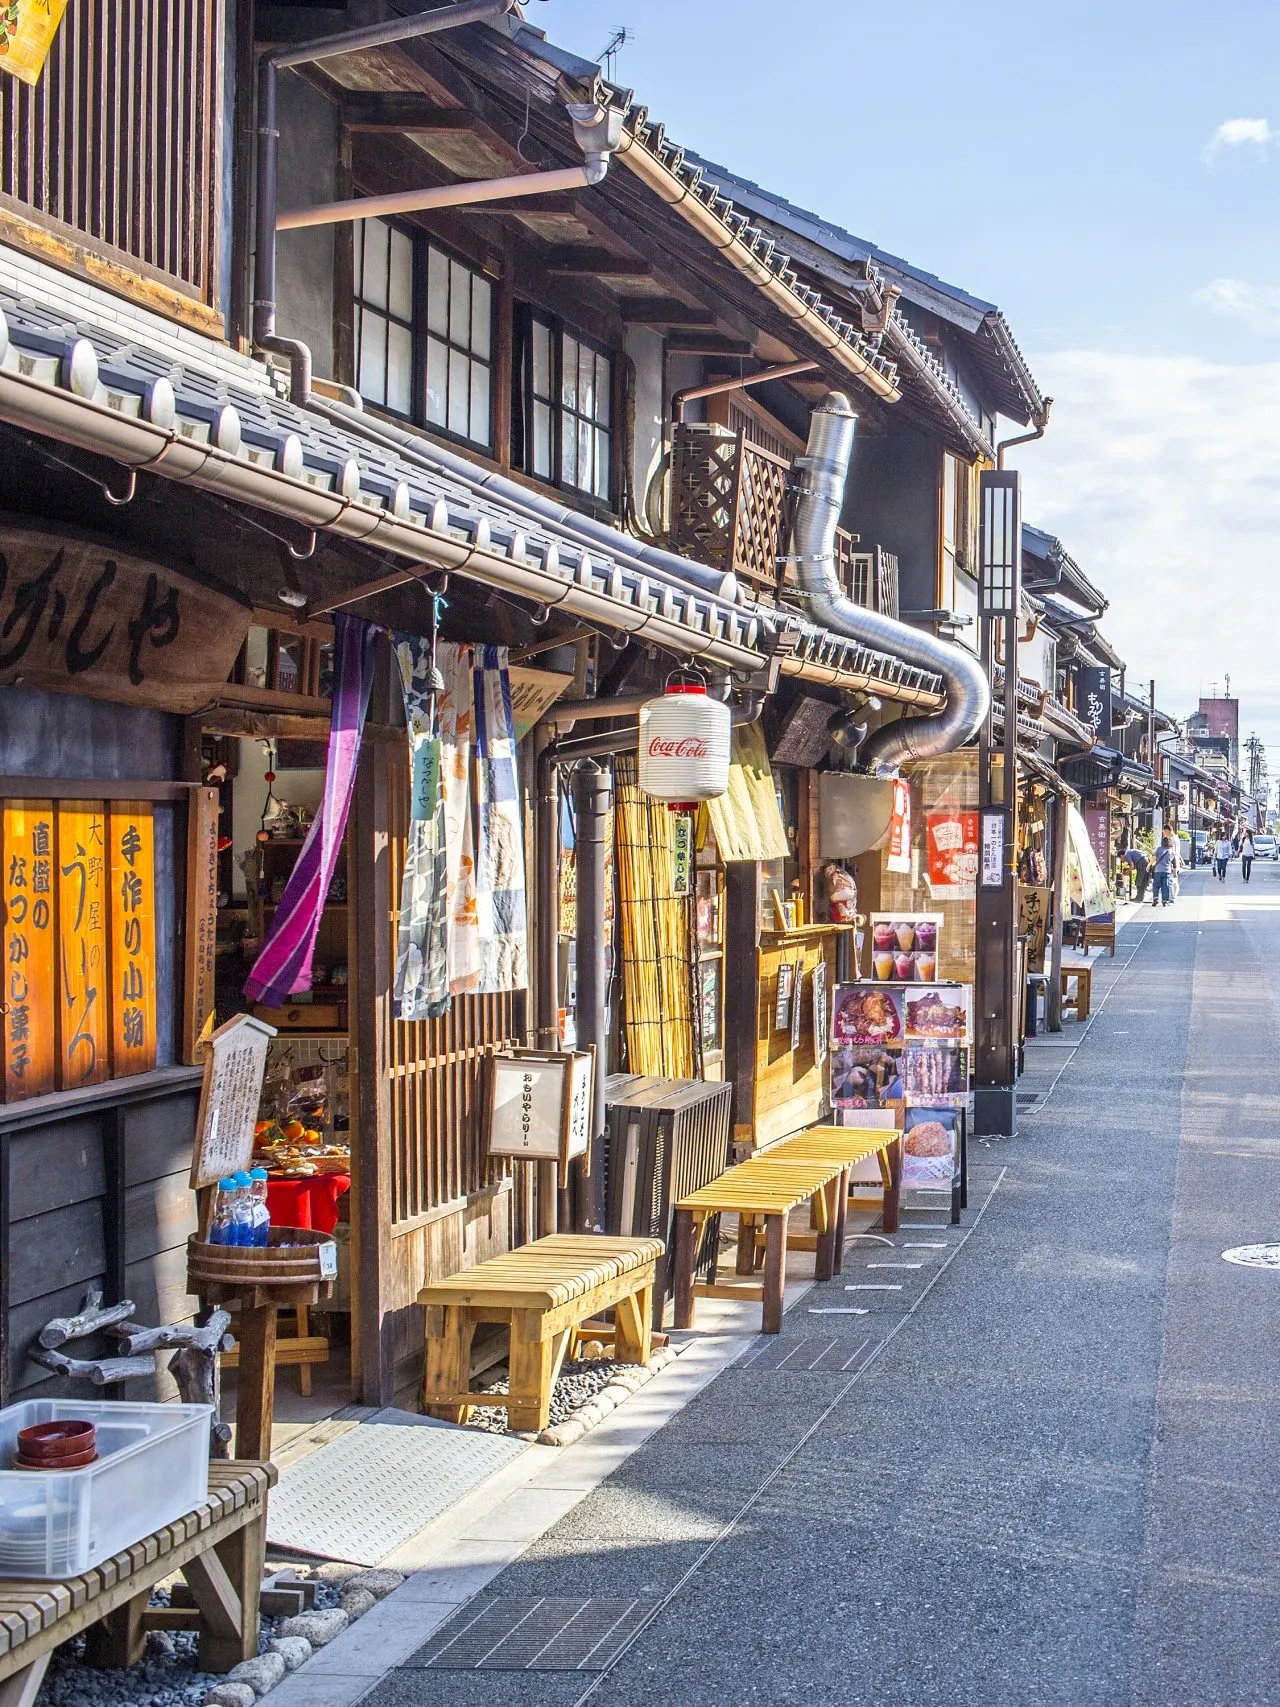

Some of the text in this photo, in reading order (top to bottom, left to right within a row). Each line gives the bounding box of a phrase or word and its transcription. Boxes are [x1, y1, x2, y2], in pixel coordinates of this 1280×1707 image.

[0, 547, 180, 686] かしや
[648, 737, 711, 758] Coca-Cola
[9, 855, 31, 1078] なつかし菓子
[87, 815, 104, 968] 大野屋の
[121, 825, 145, 1048] 手作り小物
